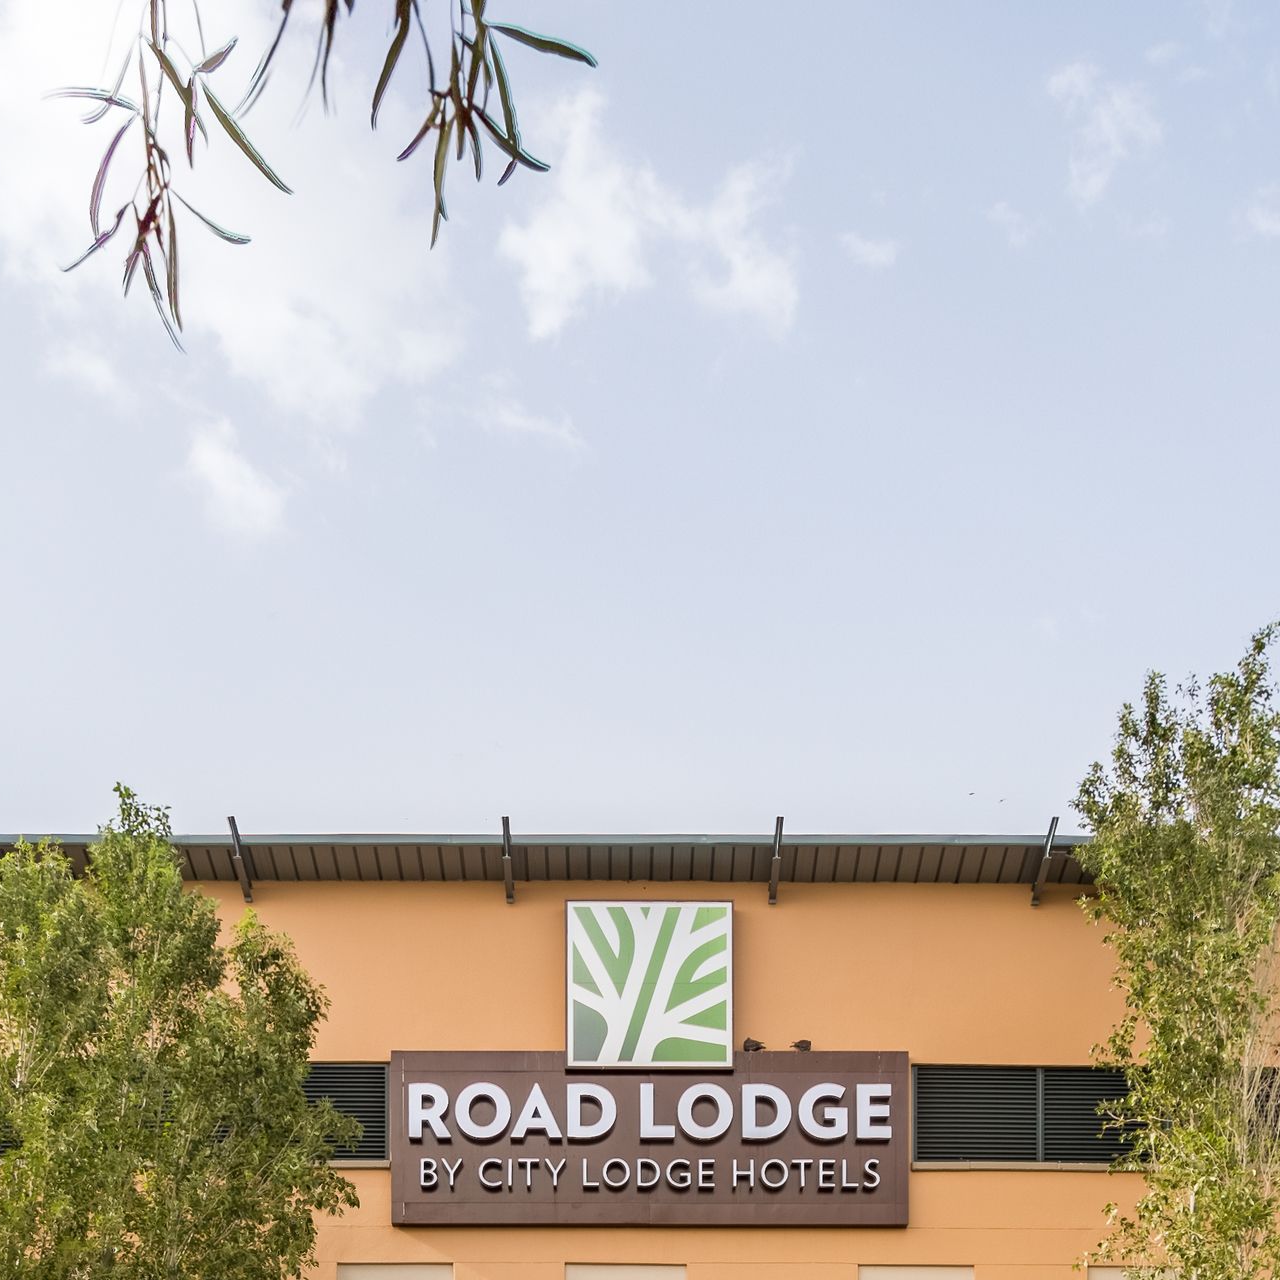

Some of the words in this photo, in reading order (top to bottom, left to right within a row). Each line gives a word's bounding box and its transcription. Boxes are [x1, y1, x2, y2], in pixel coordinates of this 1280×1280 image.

[408, 1082, 617, 1141] ROAD
[639, 1082, 892, 1141] LODGE
[420, 1157, 463, 1189] BY
[478, 1157, 566, 1190] CITY
[582, 1157, 715, 1190] LODGE
[732, 1158, 881, 1190] HOTELS
